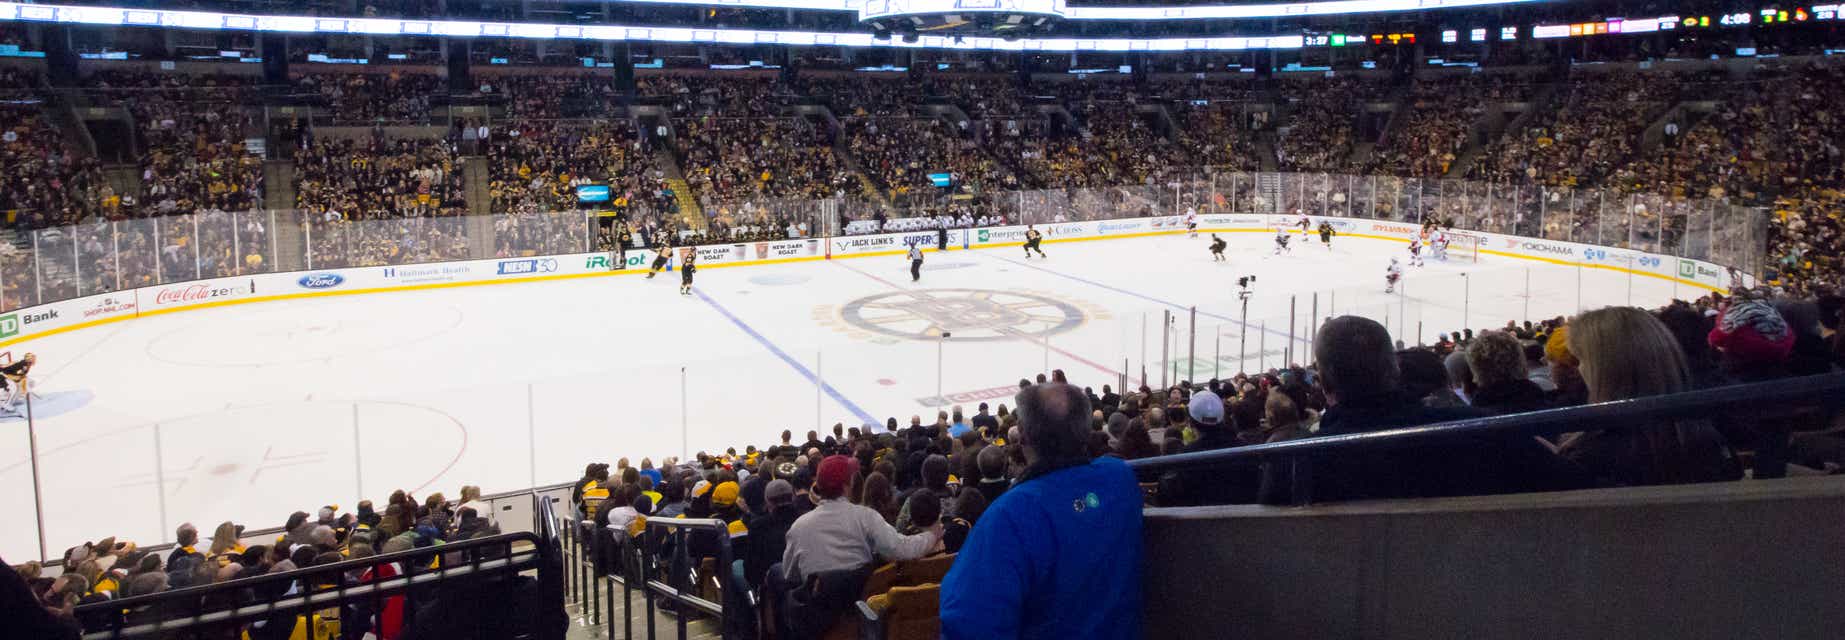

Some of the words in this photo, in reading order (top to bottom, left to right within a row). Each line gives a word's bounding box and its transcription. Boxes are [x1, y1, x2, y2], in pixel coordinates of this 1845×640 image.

[1720, 13, 1751, 25] 4:08
[1305, 36, 1329, 46] 3:27
[306, 275, 337, 287] Ford
[24, 309, 58, 324] Bank
